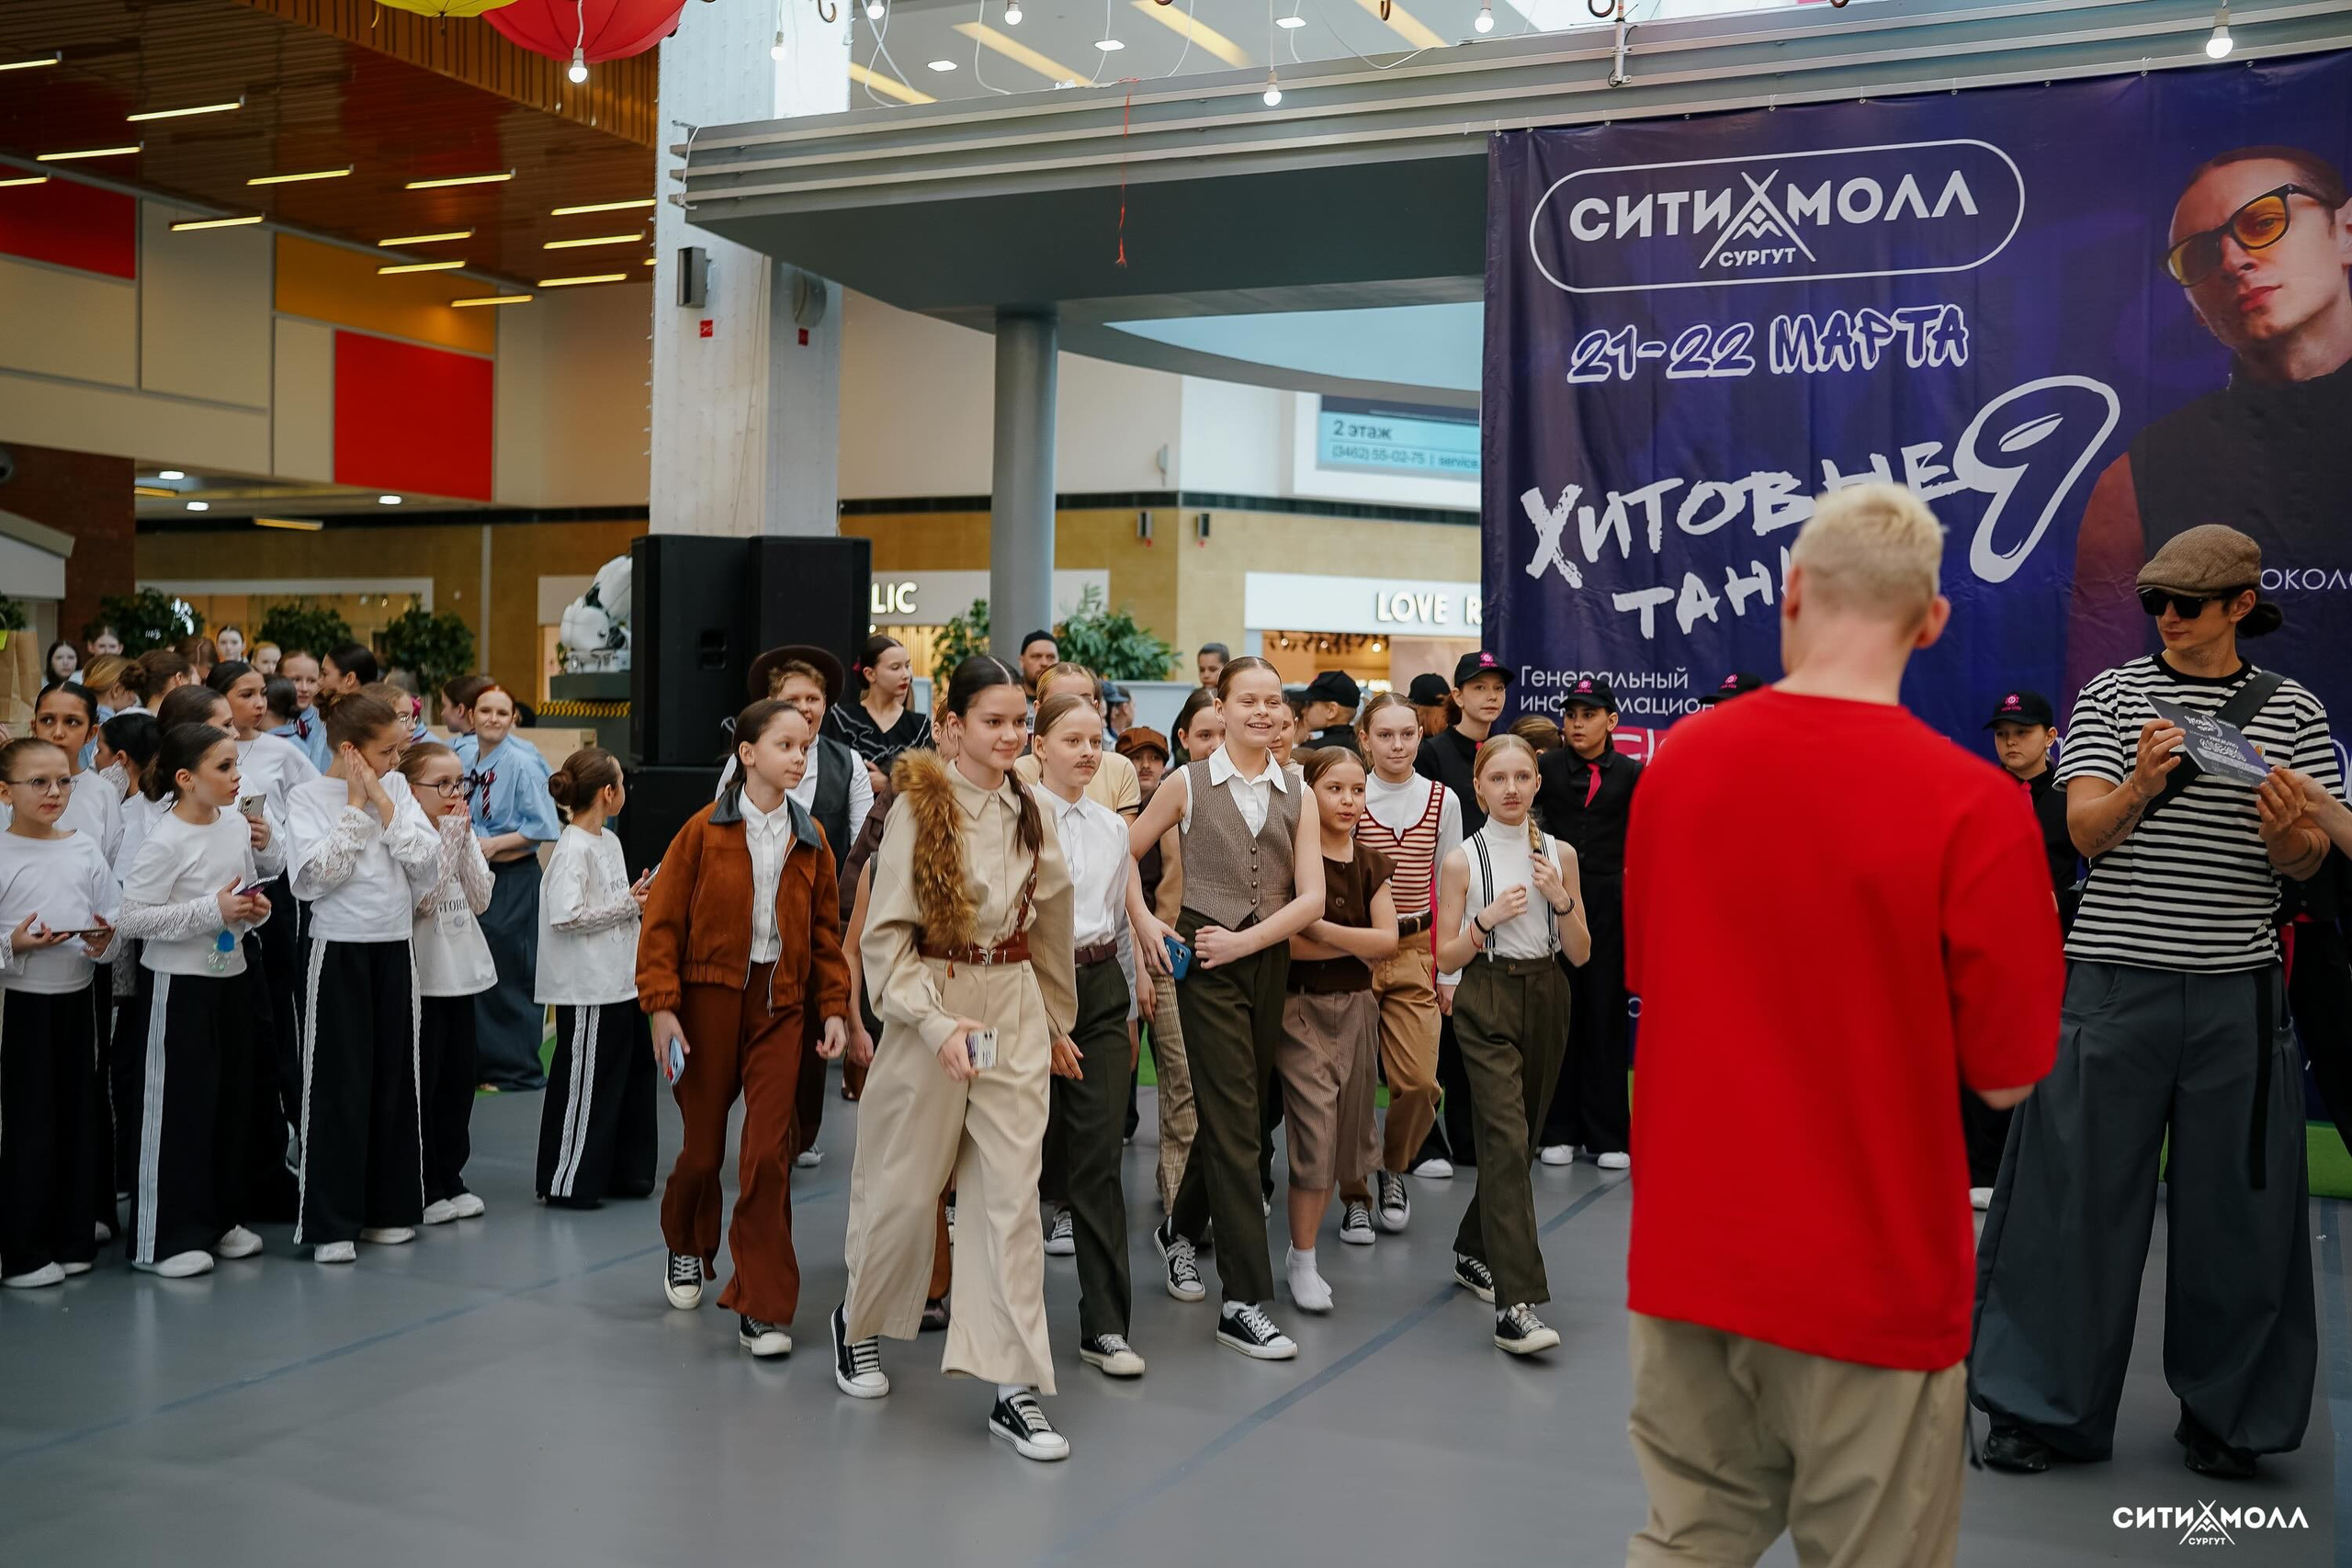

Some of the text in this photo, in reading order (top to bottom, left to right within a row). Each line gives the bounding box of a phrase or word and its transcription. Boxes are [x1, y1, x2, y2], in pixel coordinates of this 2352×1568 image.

[1569, 171, 1979, 242] СИТИ МОЛЛ
[1719, 247, 1797, 268] СУРГУТ
[1566, 304, 1969, 384] 21-22 МАРТА
[1333, 420, 1392, 441] 2 этаж
[1612, 546, 1791, 639] ТАН
[2260, 568, 2352, 591] ОКОЛ
[1376, 591, 1449, 624] LOVE
[1520, 690, 1715, 717] инфмацио
